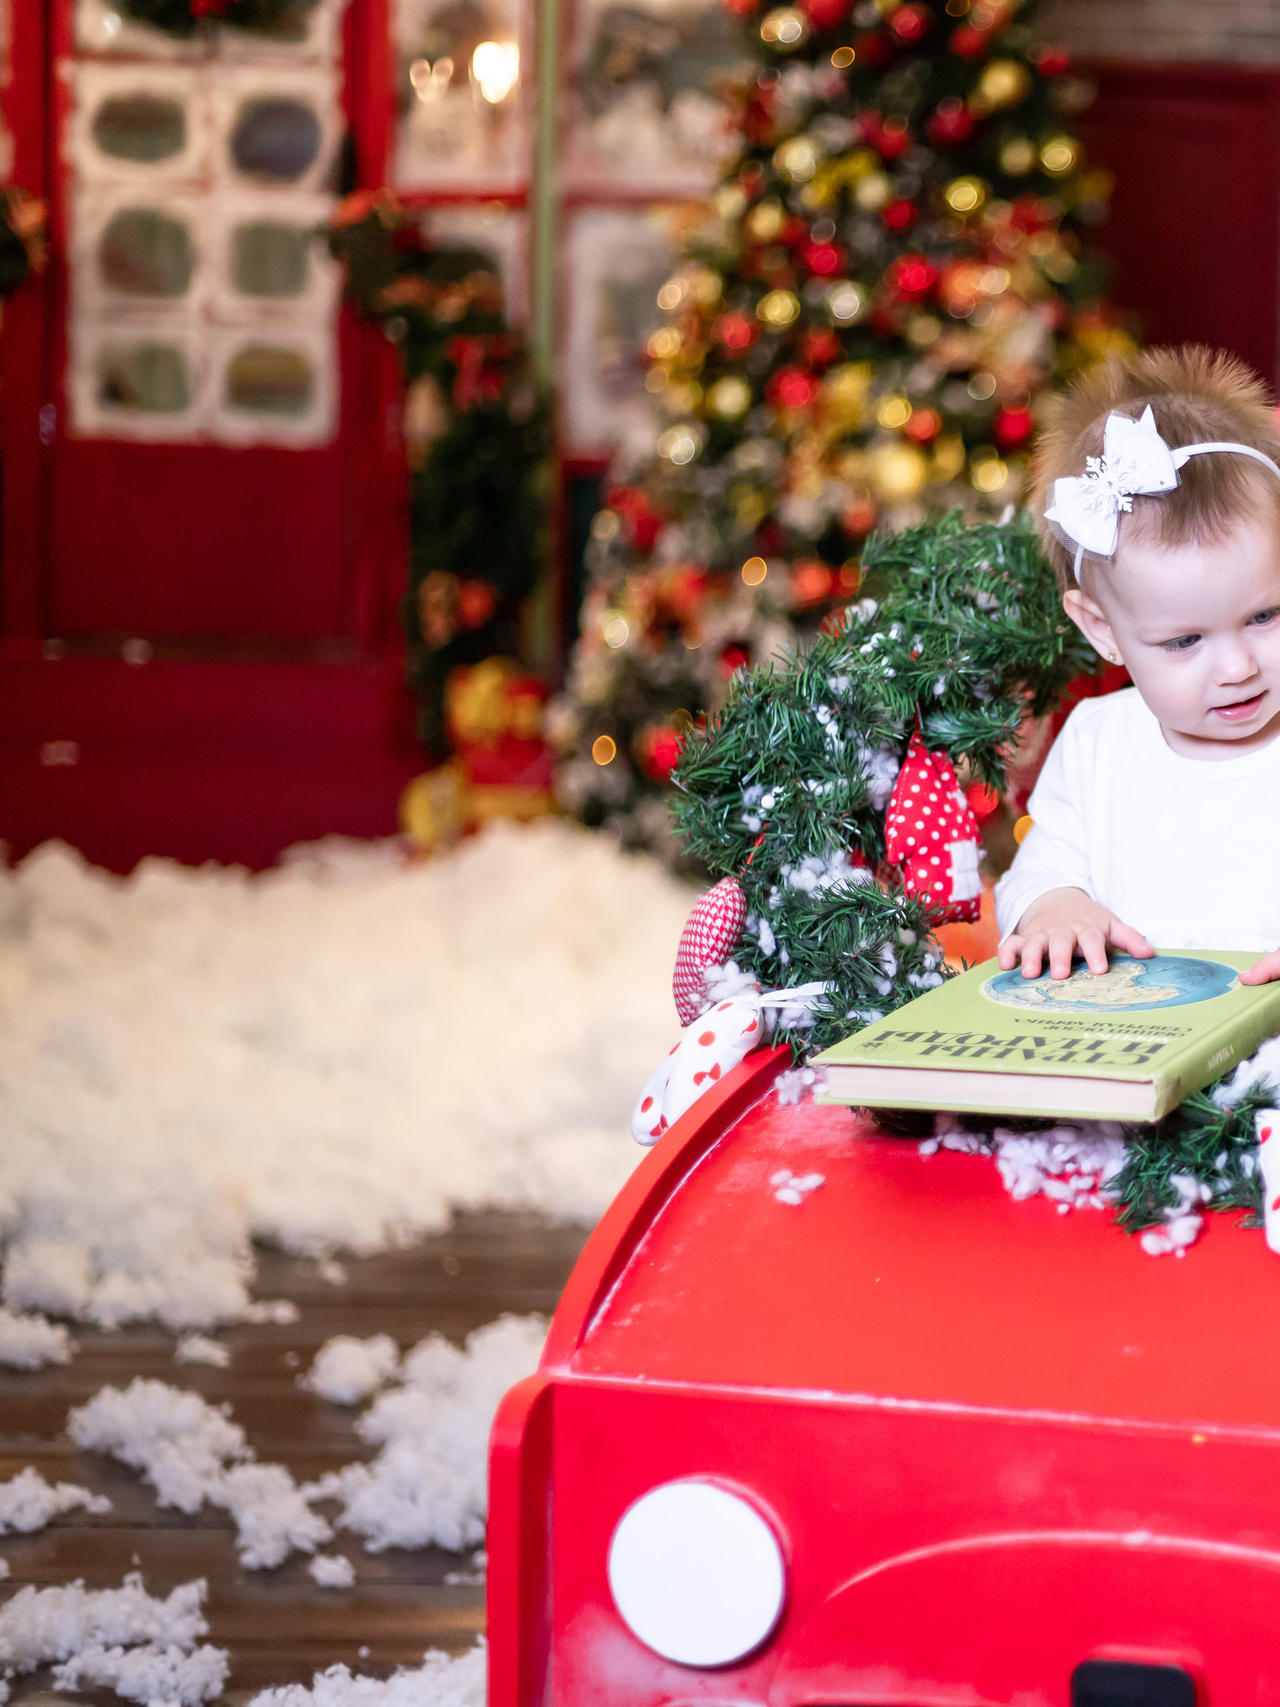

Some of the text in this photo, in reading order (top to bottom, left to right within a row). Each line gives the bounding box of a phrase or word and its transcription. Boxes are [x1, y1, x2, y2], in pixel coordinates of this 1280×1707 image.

[1014, 1018, 1193, 1032] СЕВЕРНАЯ АФРИКА
[870, 1030, 1112, 1050] НАРОДЫ
[1083, 1032, 1169, 1043] АФРИКА
[918, 1045, 1151, 1065] СТРАНЫ
[1119, 1042, 1168, 1054] И
